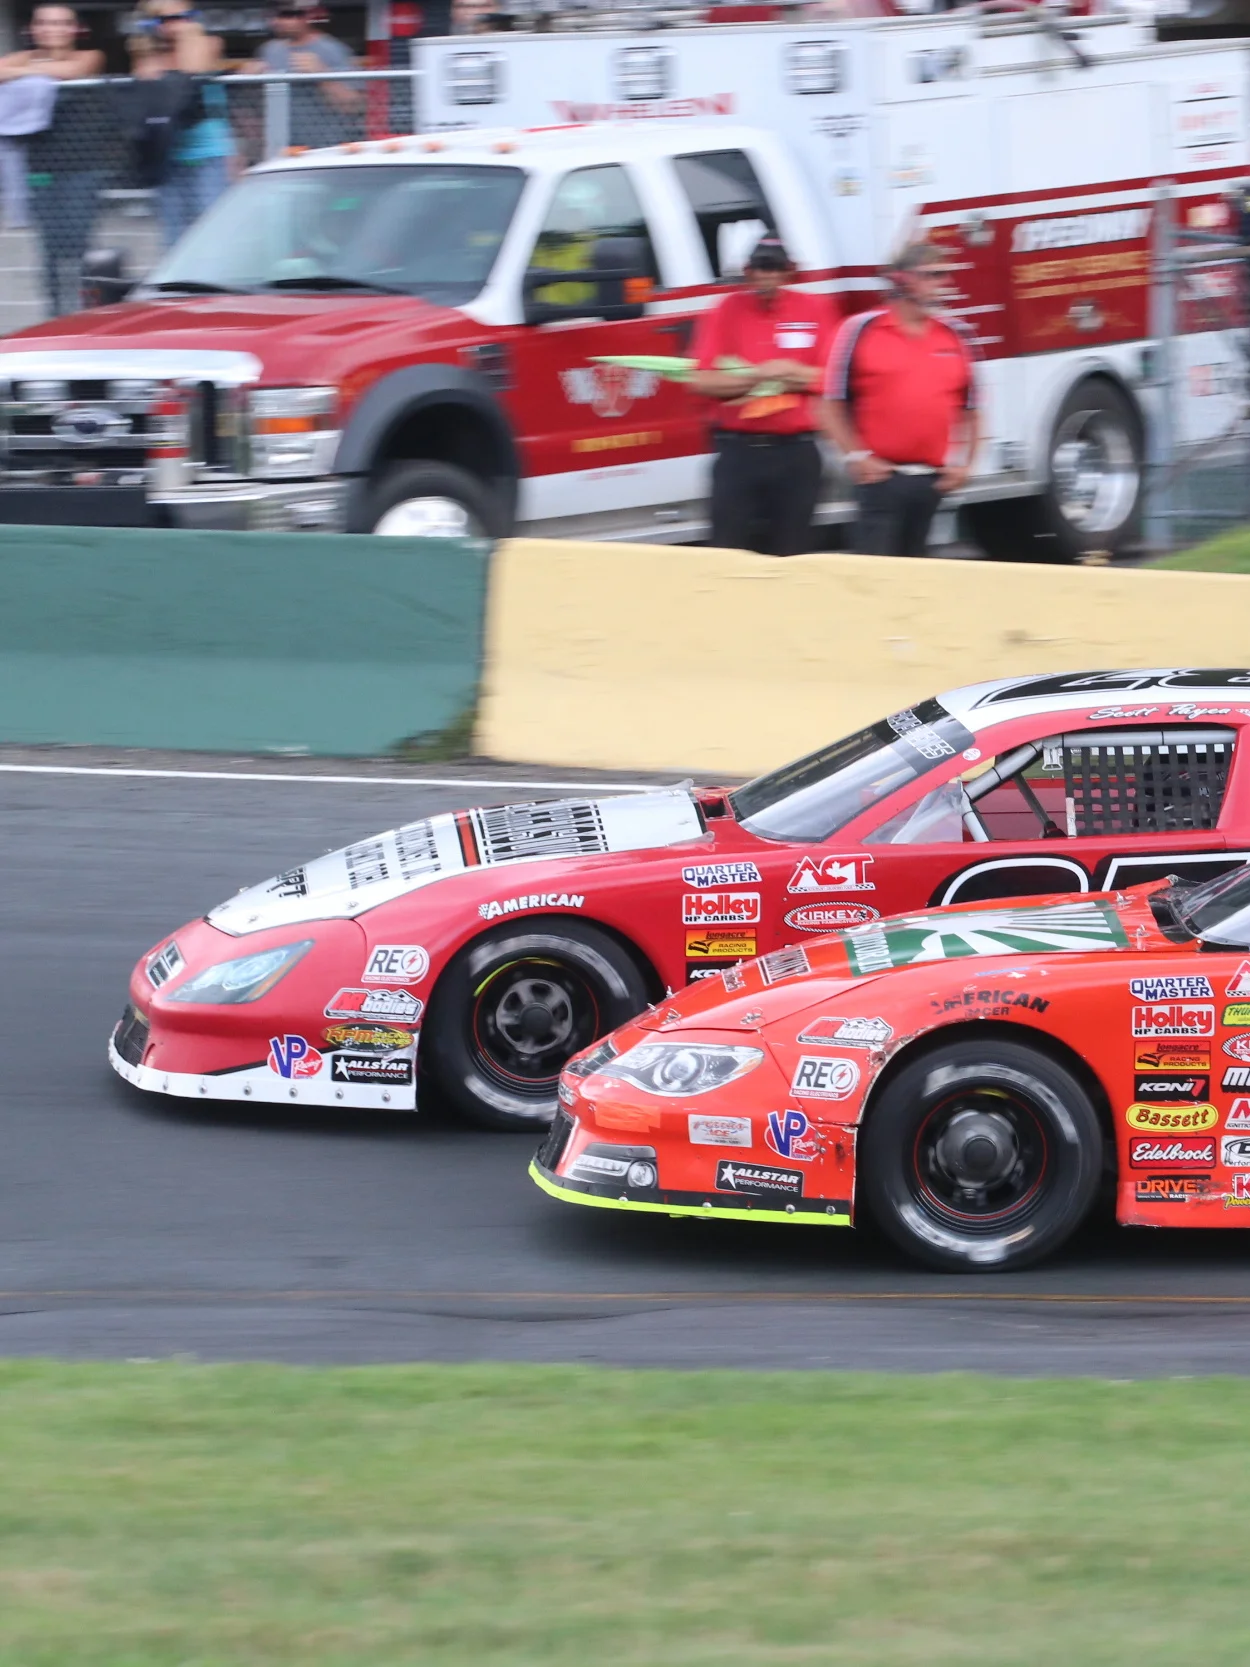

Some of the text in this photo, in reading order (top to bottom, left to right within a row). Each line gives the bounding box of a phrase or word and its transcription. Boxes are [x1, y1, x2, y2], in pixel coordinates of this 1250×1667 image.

[1089, 706, 1159, 720] Scott
[683, 862, 754, 881] QUARTER
[788, 853, 874, 888] ACT
[697, 872, 758, 887] MASTER
[484, 894, 585, 920] AMERICAN
[685, 895, 758, 920] Holley
[797, 910, 858, 920] KIRKEY
[706, 931, 746, 940] longacre
[690, 969, 728, 979] KO
[1132, 977, 1206, 994] QUARTER
[1145, 987, 1210, 1001] MASTER
[1135, 1006, 1211, 1034] Holley
[1156, 1043, 1199, 1052] longacre
[269, 1034, 308, 1079] VP
[348, 1060, 408, 1071] ALLSTAR
[348, 1070, 408, 1079] PERFORMANCE
[1136, 1108, 1209, 1128] Bassett
[768, 1109, 808, 1157] VP
[1132, 1143, 1214, 1161] Edelbrock
[734, 1167, 798, 1184] ALLSTAR
[735, 1178, 799, 1193] PERFORMANCE
